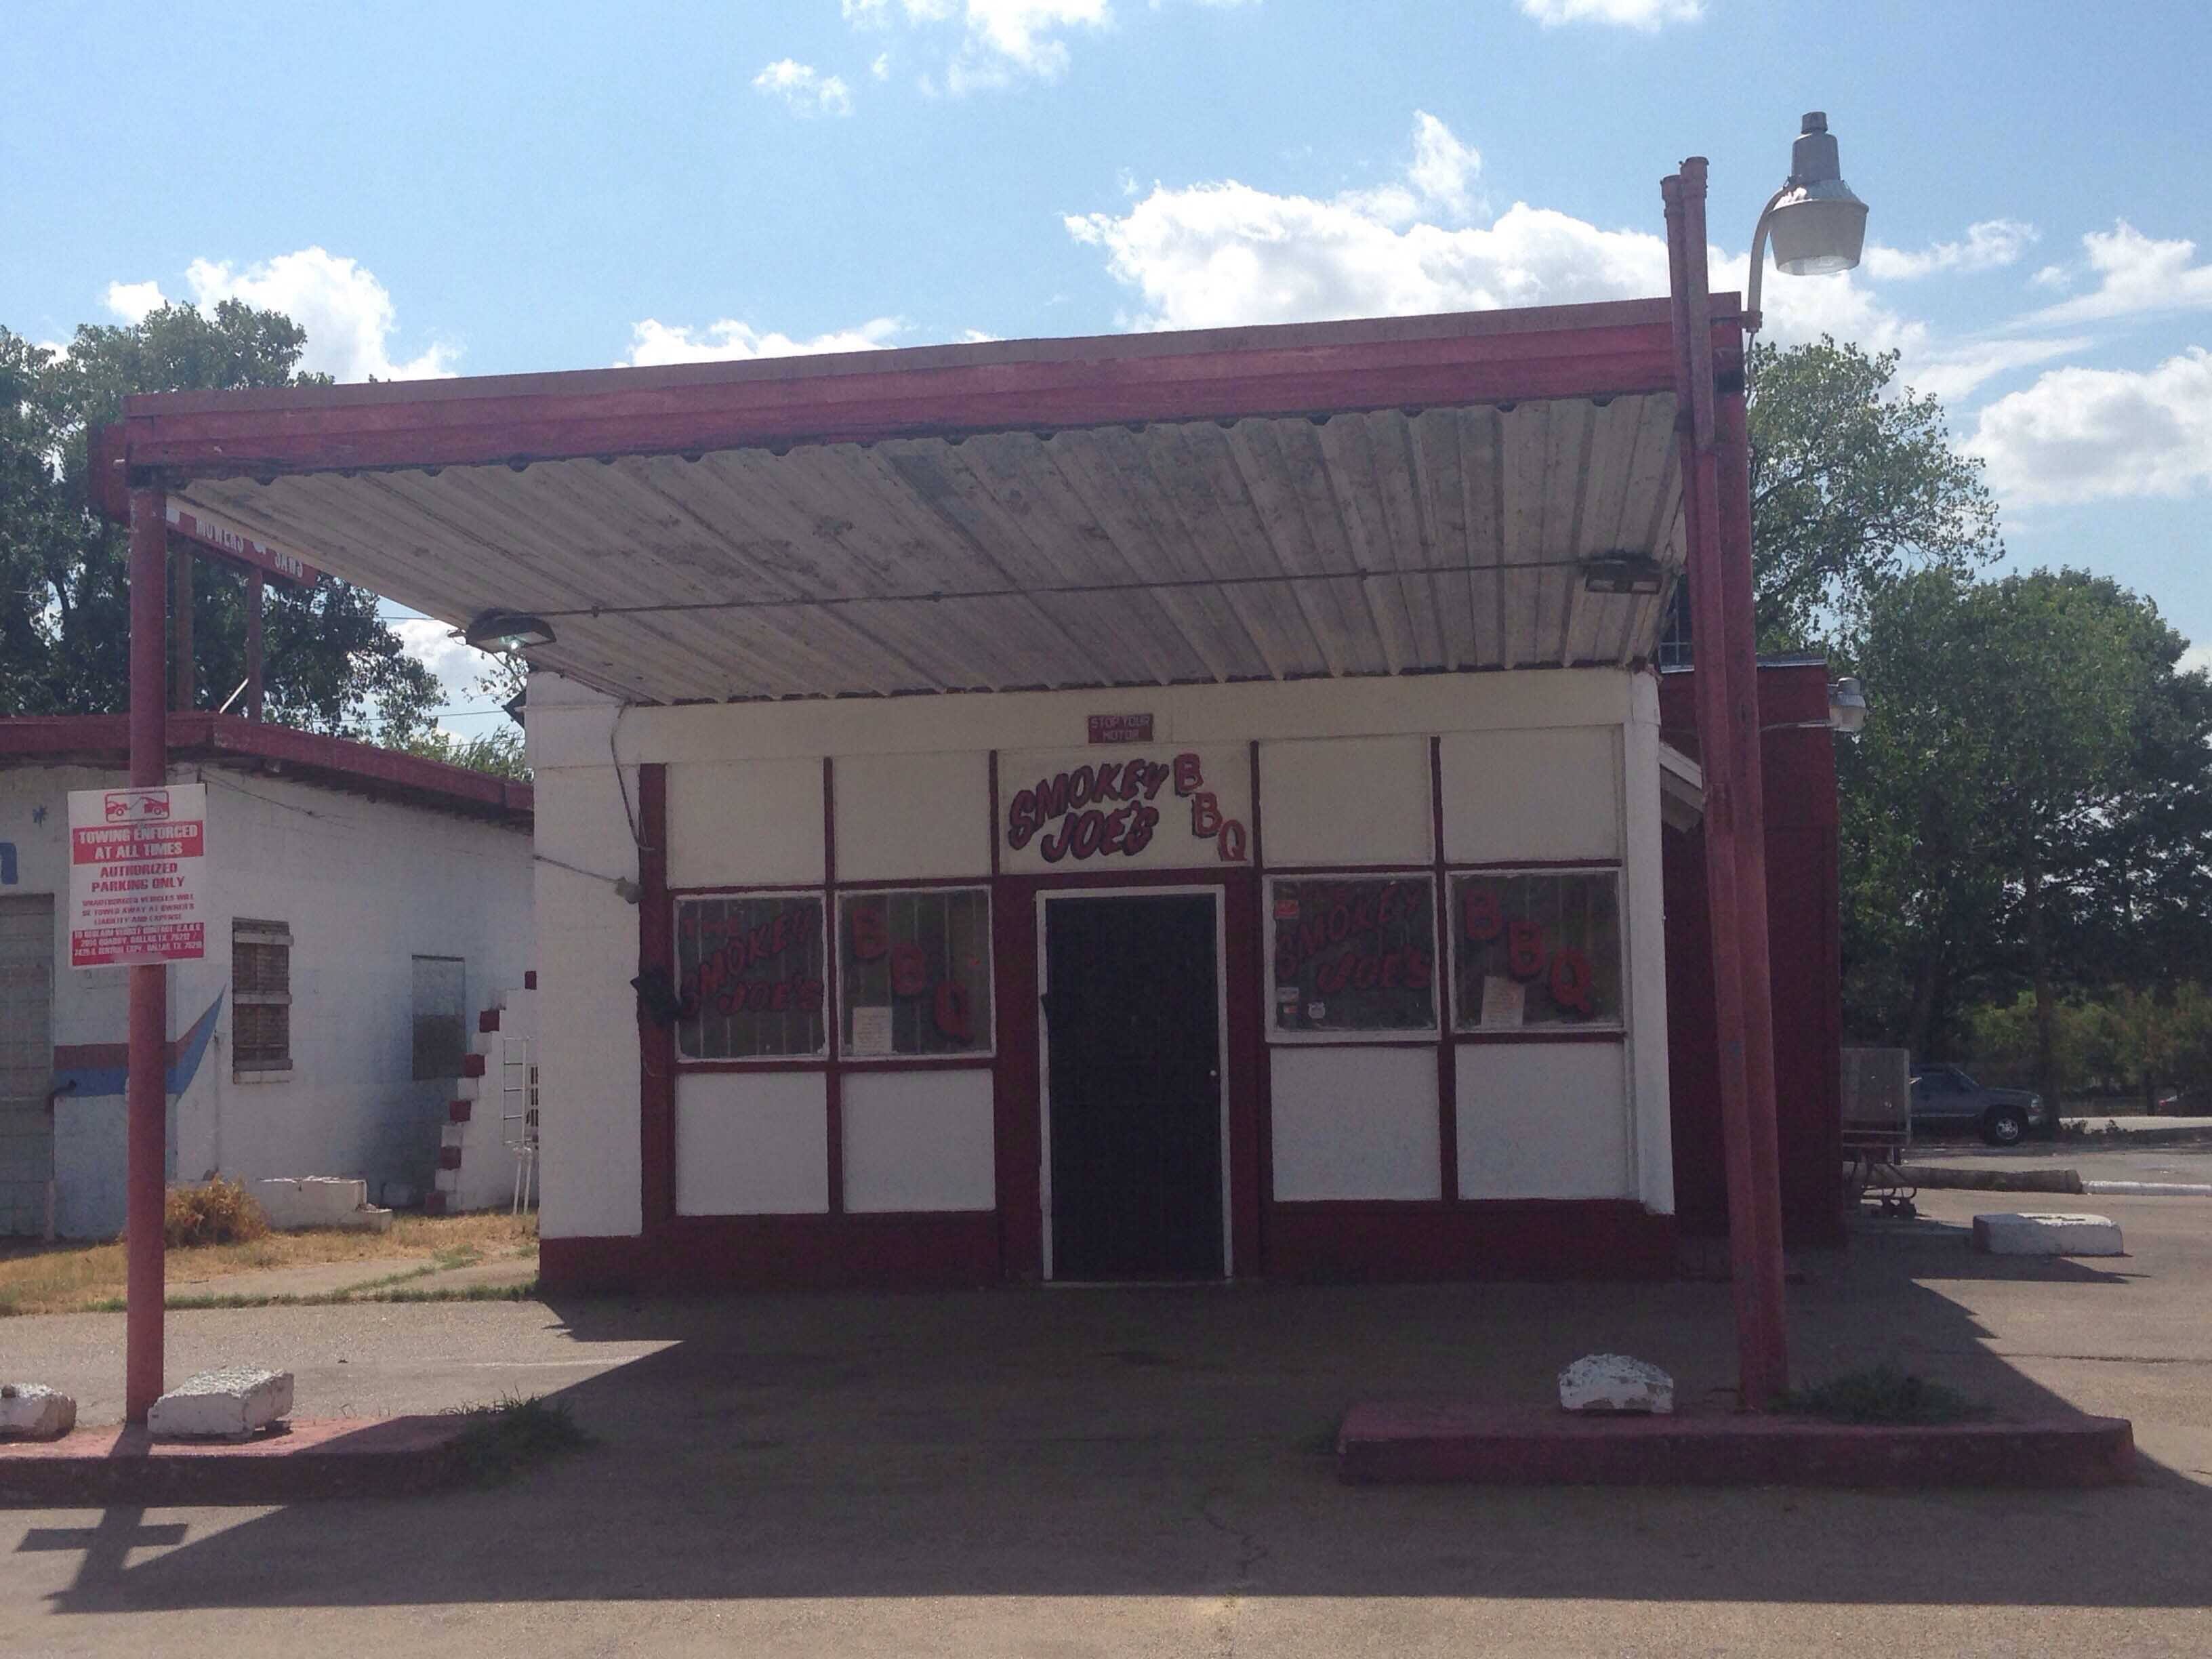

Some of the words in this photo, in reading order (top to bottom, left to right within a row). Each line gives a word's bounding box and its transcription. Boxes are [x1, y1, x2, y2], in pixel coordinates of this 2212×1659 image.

[1090, 715, 1120, 729] STOP
[1121, 714, 1150, 728] YOUR
[1102, 728, 1139, 743] MOTOR
[1008, 758, 1170, 851] SMOKEY
[1174, 753, 1248, 862] BBQ
[79, 828, 131, 844] TOWING
[134, 824, 199, 842] ENFORCED
[1040, 799, 1160, 863] JOE'S
[94, 846, 113, 859] AT
[116, 844, 138, 859] ALL
[143, 842, 183, 857] TIMES
[100, 862, 178, 878] AUTHORIZED
[91, 878, 148, 893] PARKING
[152, 876, 185, 888] ONLY
[94, 907, 120, 916] TOWED
[122, 905, 146, 914] AWAY
[131, 915, 148, 923] AND
